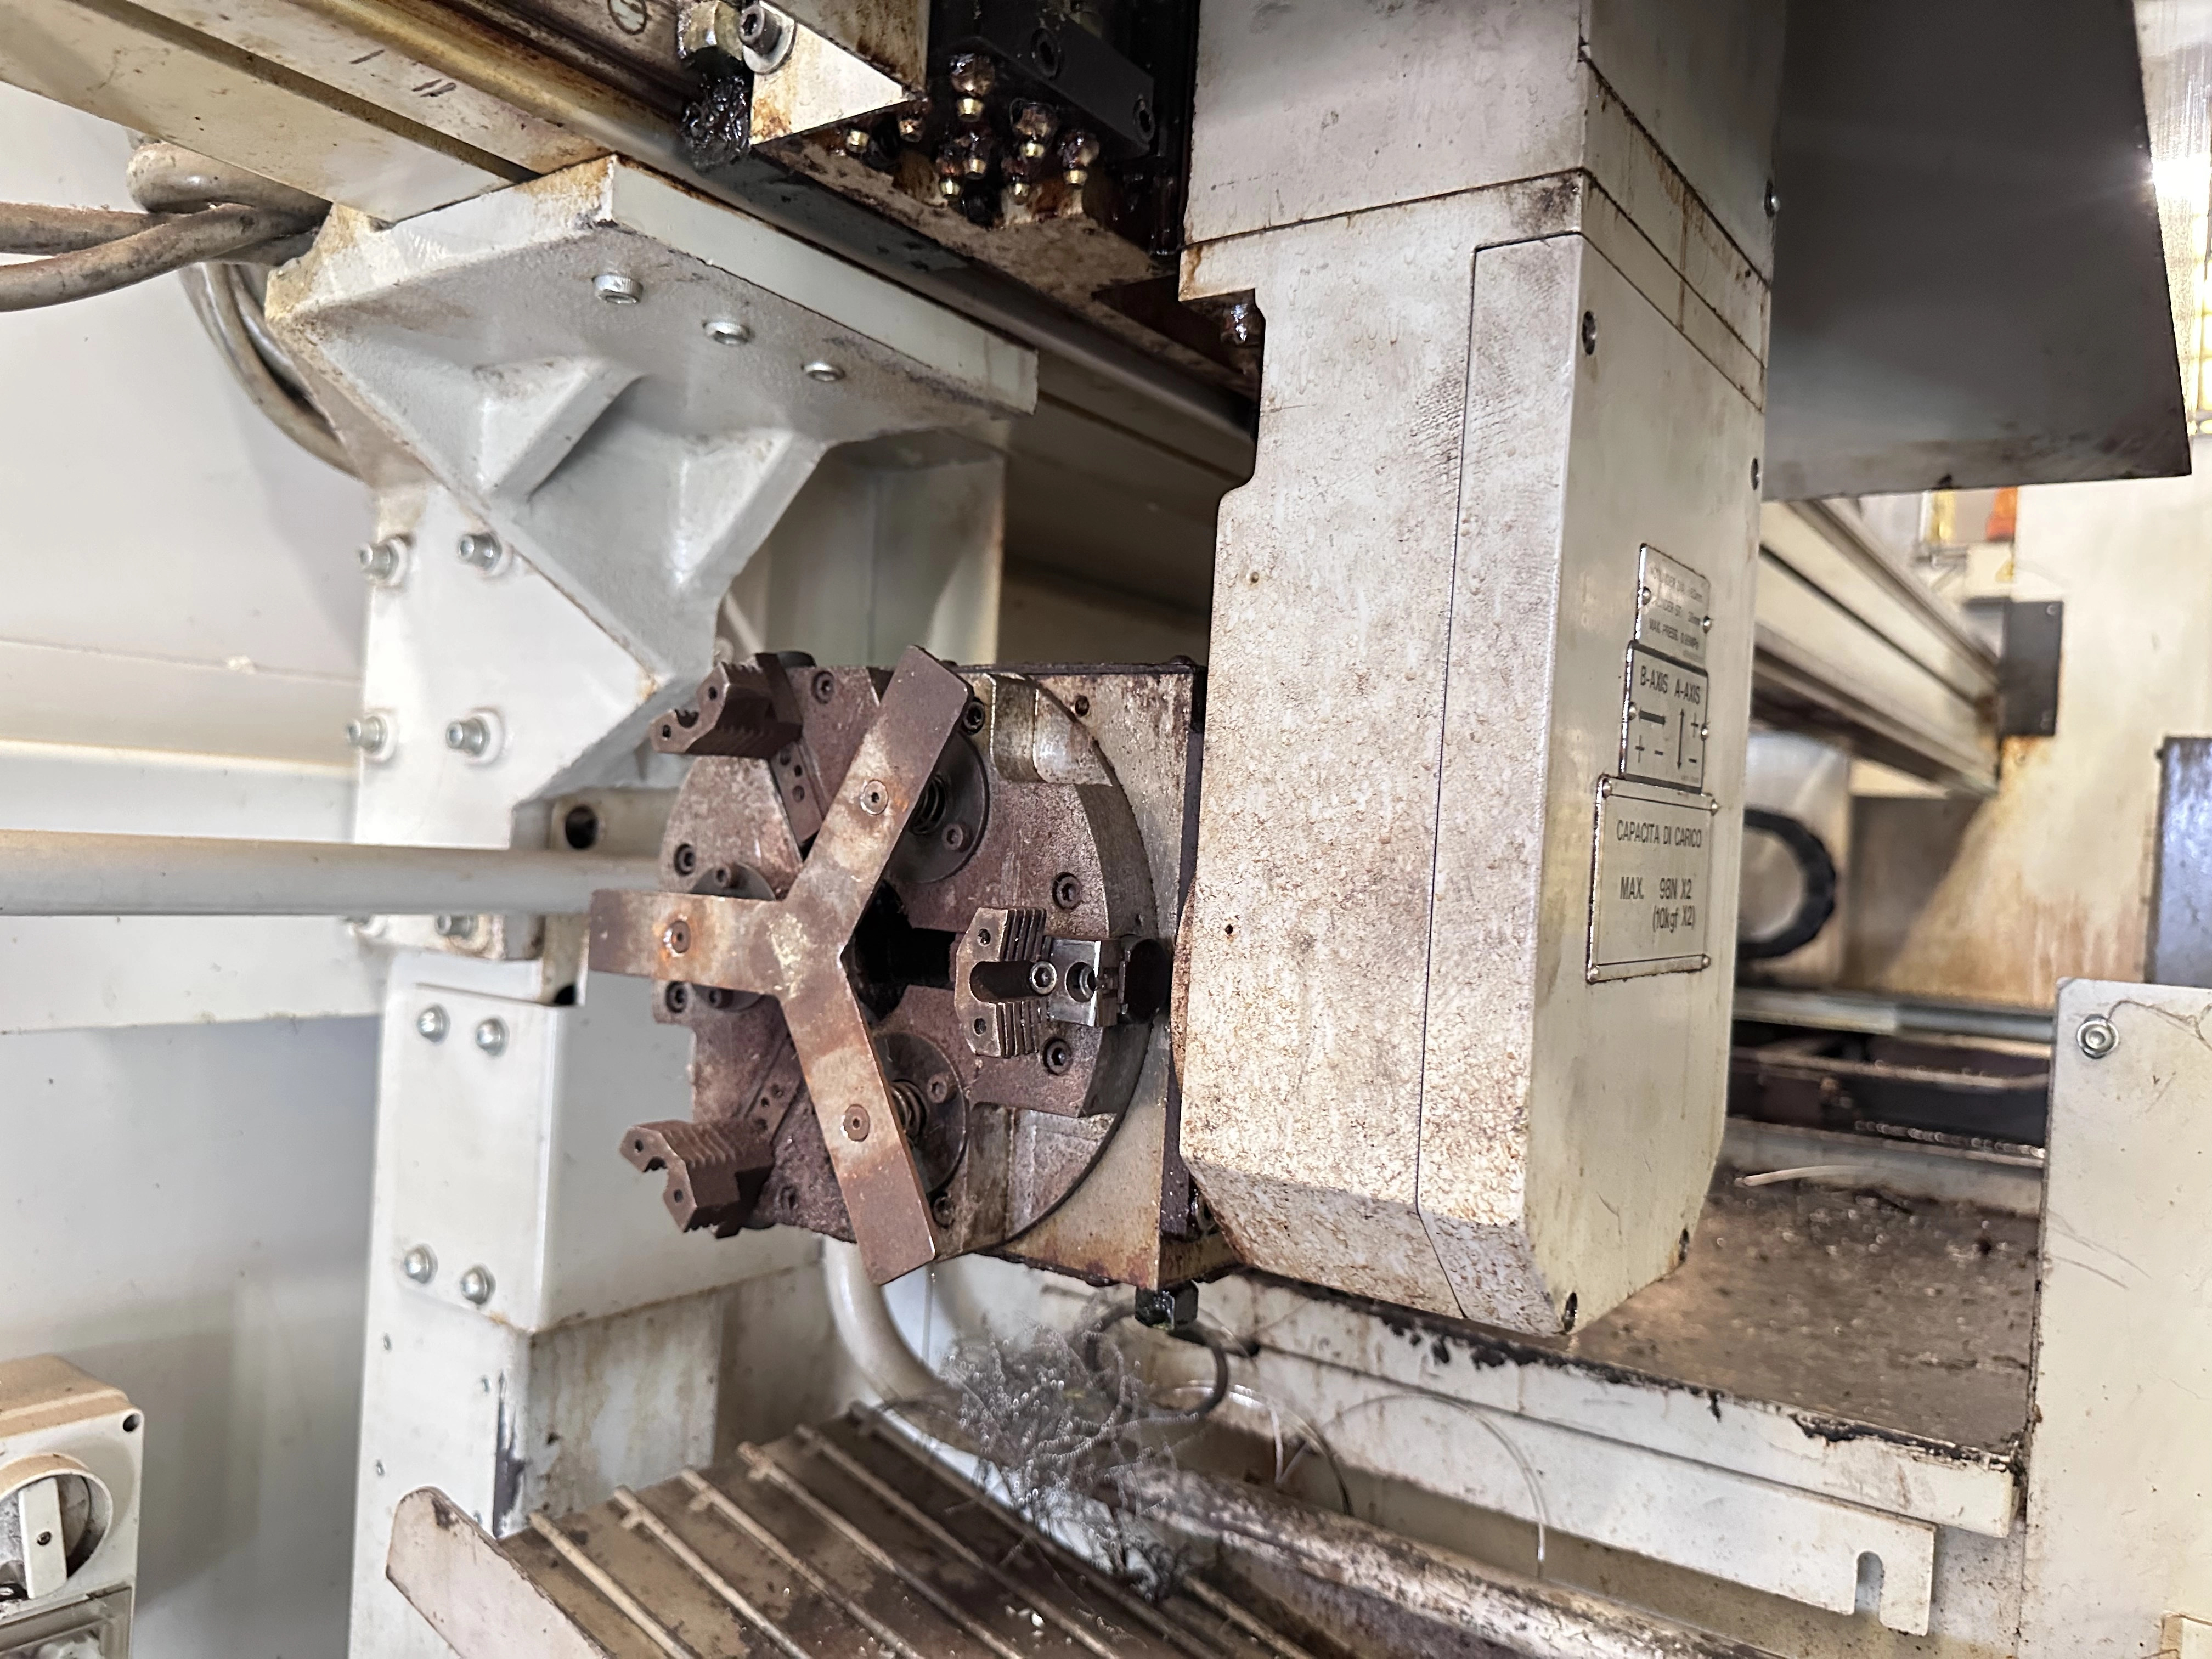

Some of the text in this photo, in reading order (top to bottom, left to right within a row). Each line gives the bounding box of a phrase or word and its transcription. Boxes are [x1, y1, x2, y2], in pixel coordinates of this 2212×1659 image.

[1640, 665, 1701, 705] B-AXIS A-AXIS
[1616, 820, 1702, 848] CAPACITA DI CARICO
[1620, 877, 1692, 900] MAX. 98N X2
[1652, 905, 1695, 933] (10kgf X2)
